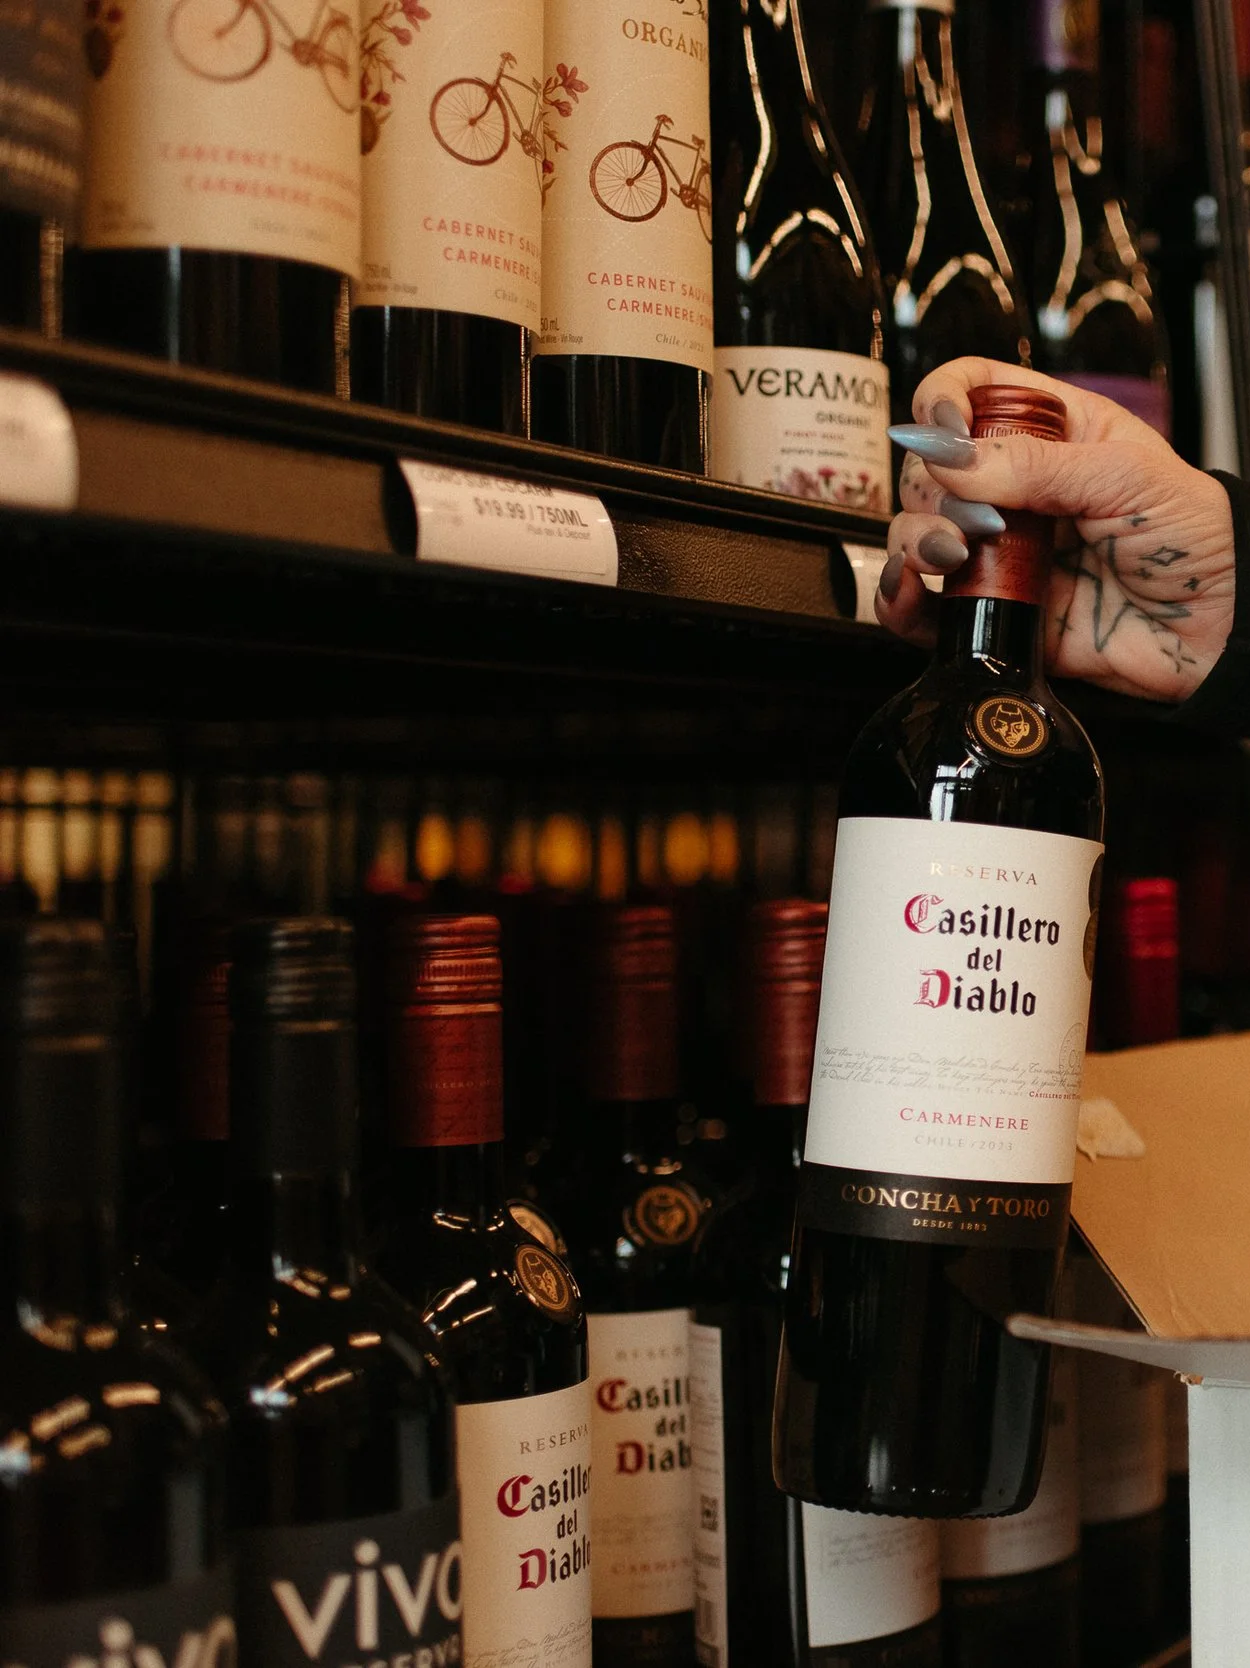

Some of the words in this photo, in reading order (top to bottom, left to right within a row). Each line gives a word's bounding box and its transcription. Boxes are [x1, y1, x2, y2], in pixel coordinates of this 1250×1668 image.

[422, 217, 514, 245] CABERNET
[587, 272, 676, 293] CABERNET
[539, 317, 550, 332] 50
[655, 333, 681, 347] Chile
[930, 862, 1038, 885] RESERVA
[904, 893, 1060, 946] Casillero
[967, 947, 1001, 972] del
[914, 968, 1037, 1016] Diablo
[899, 1107, 1029, 1131] CARMENERE
[841, 1183, 963, 1214] CONCHA
[986, 1196, 1050, 1220] TORO
[912, 1217, 953, 1229] DESDE
[656, 1414, 686, 1437] del
[520, 1423, 589, 1455] RESERVA
[557, 1509, 578, 1539] del
